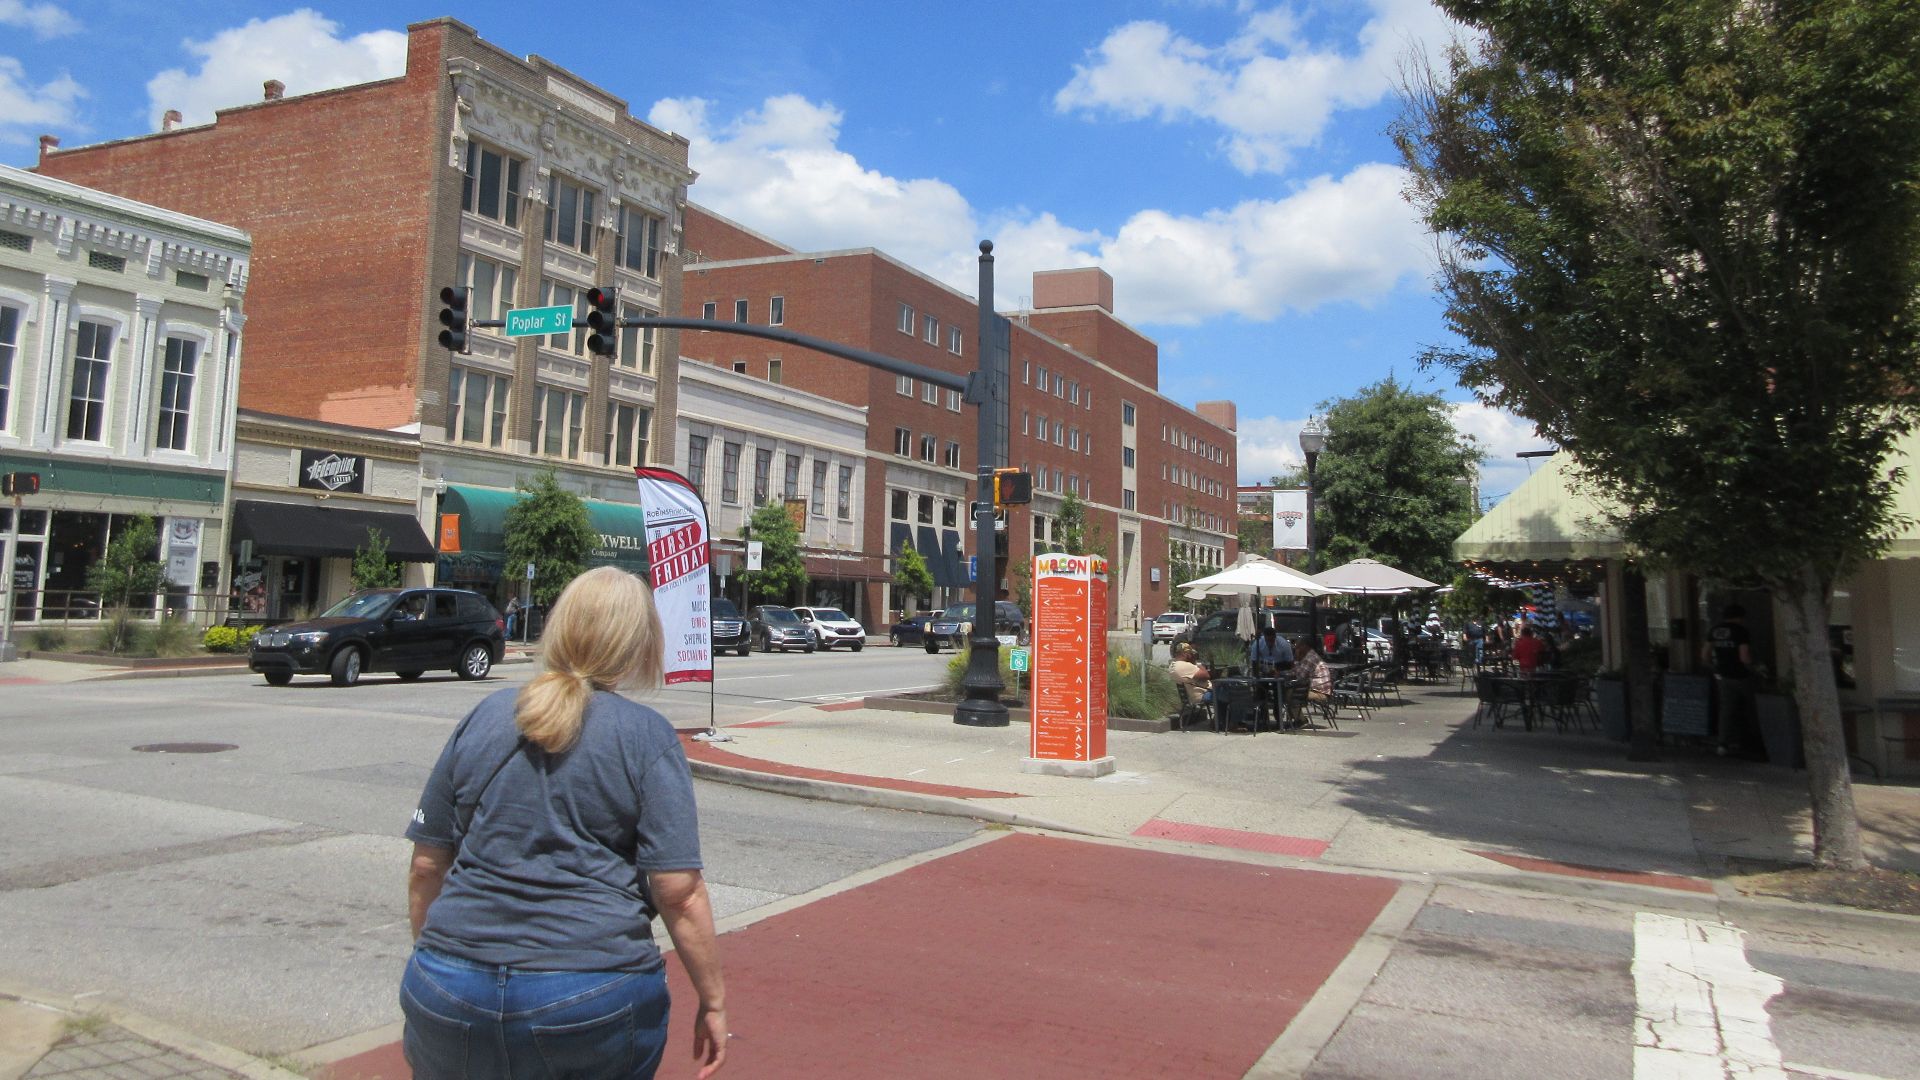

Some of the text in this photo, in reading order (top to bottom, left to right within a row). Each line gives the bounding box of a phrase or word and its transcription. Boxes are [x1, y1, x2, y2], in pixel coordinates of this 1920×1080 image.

[512, 313, 566, 332] Poplar St
[600, 534, 641, 550] XWELL
[652, 526, 692, 562] FIRST
[591, 548, 617, 558] Company
[655, 544, 705, 585] FRIDAY
